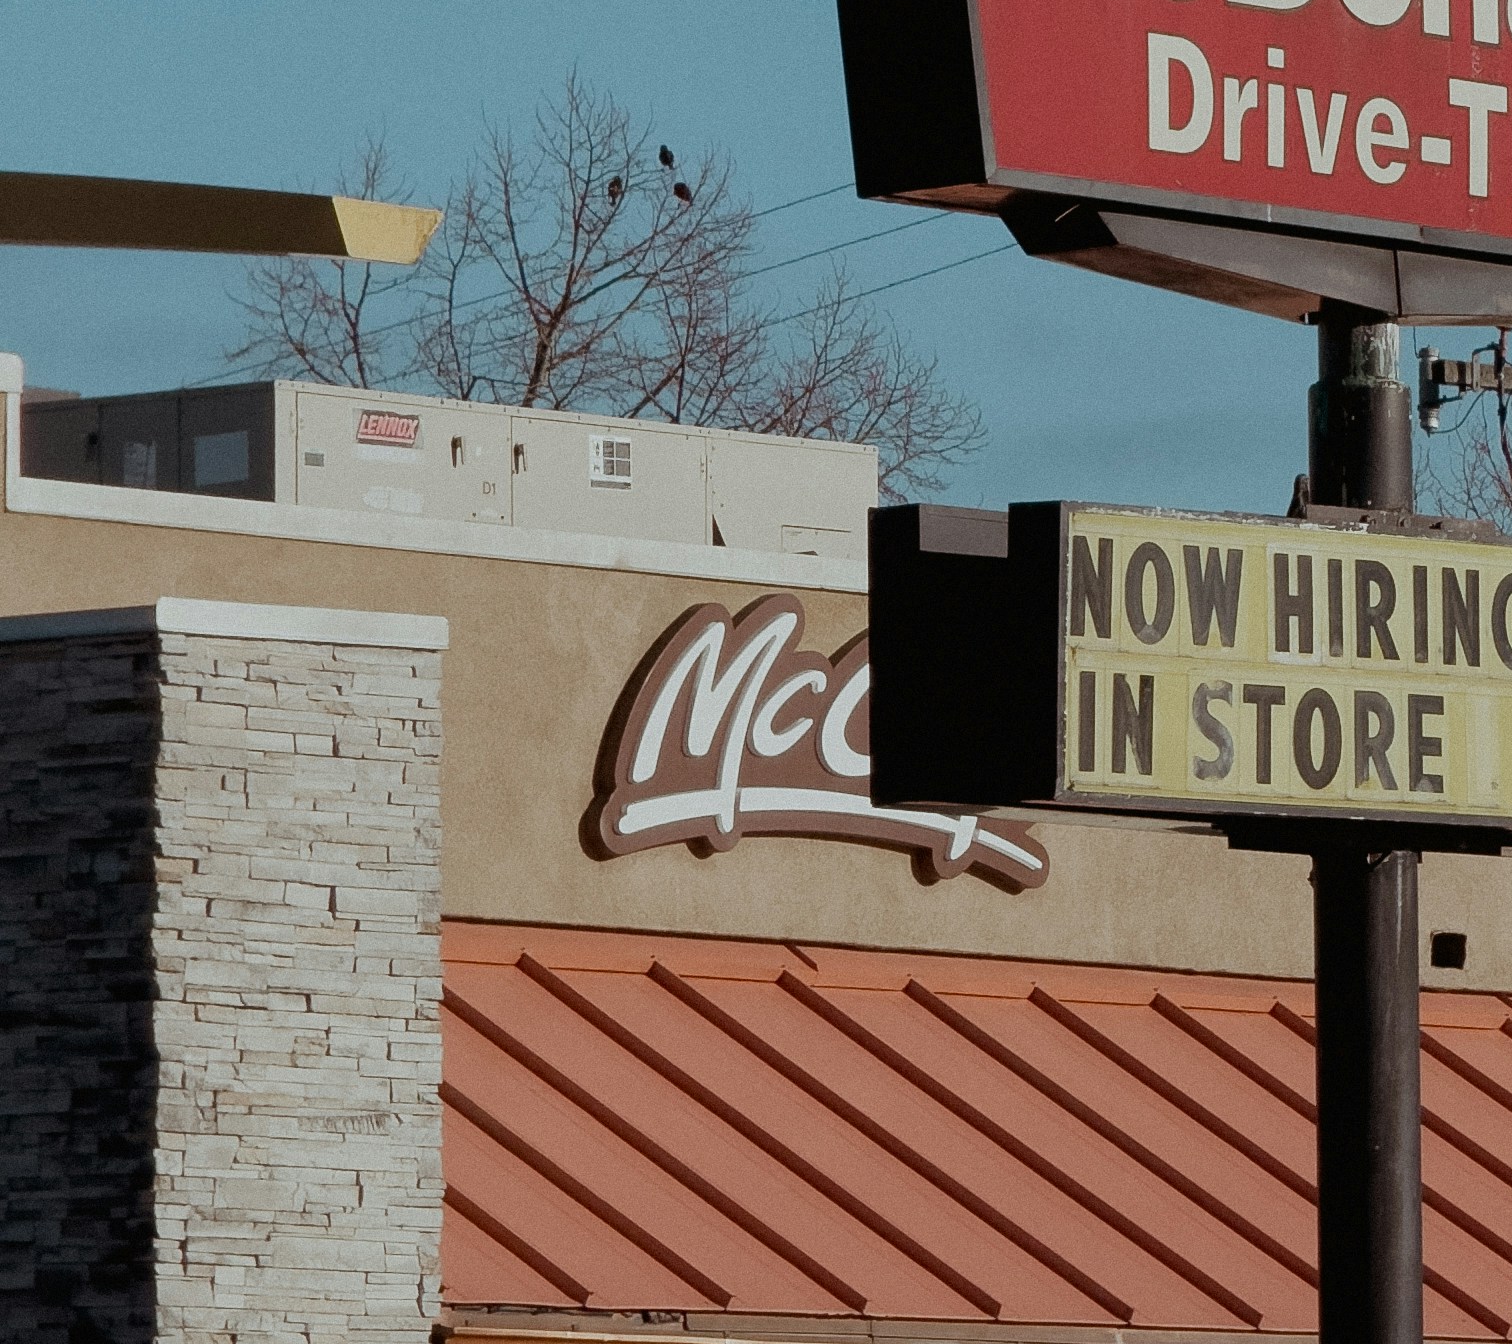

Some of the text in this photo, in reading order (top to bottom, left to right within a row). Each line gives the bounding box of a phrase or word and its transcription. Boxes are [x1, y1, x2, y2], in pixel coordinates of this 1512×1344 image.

[358, 413, 419, 440] LENNOX
[482, 481, 496, 495] D1
[1069, 534, 1244, 647] NOW
[1078, 670, 1156, 776] IN
[1190, 678, 1446, 795] STORE
